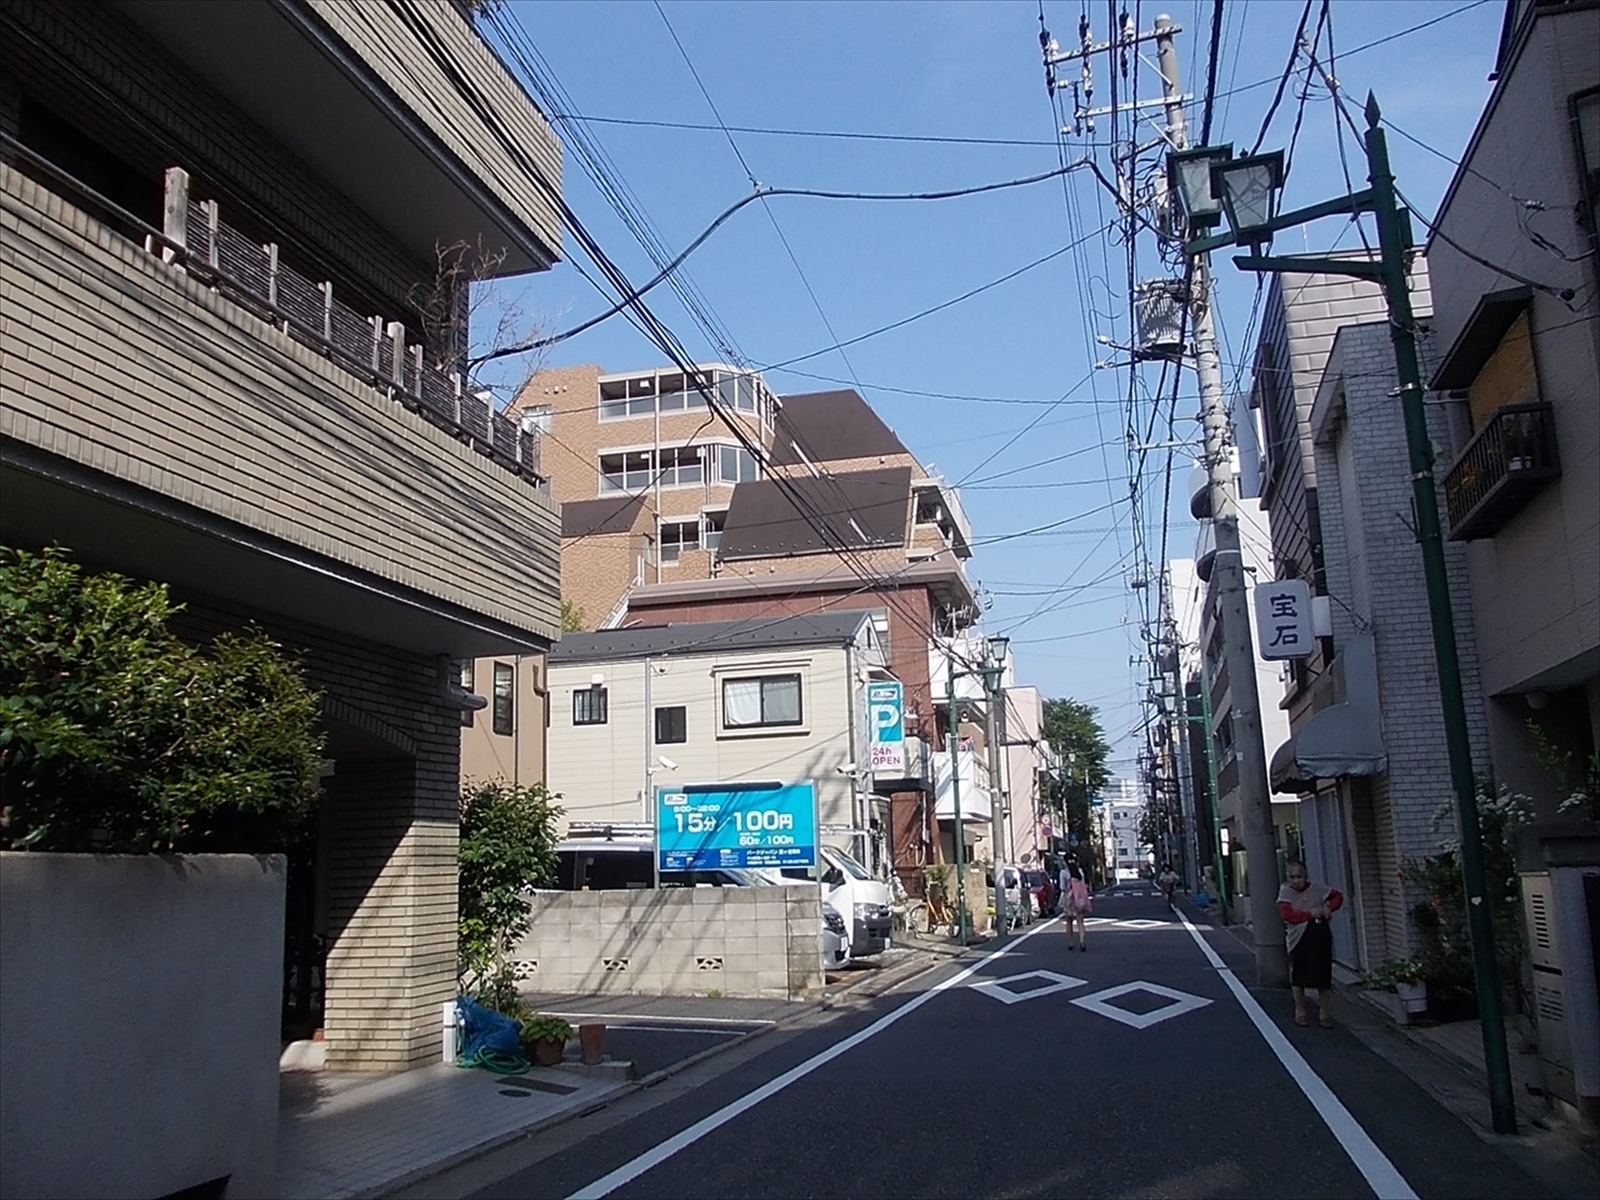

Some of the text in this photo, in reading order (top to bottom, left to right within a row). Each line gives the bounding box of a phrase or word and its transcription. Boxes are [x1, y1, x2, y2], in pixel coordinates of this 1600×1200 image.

[1268, 592, 1299, 647] 宝石
[870, 704, 900, 744] P
[872, 747, 892, 756] 24h
[872, 756, 901, 766] OPEN
